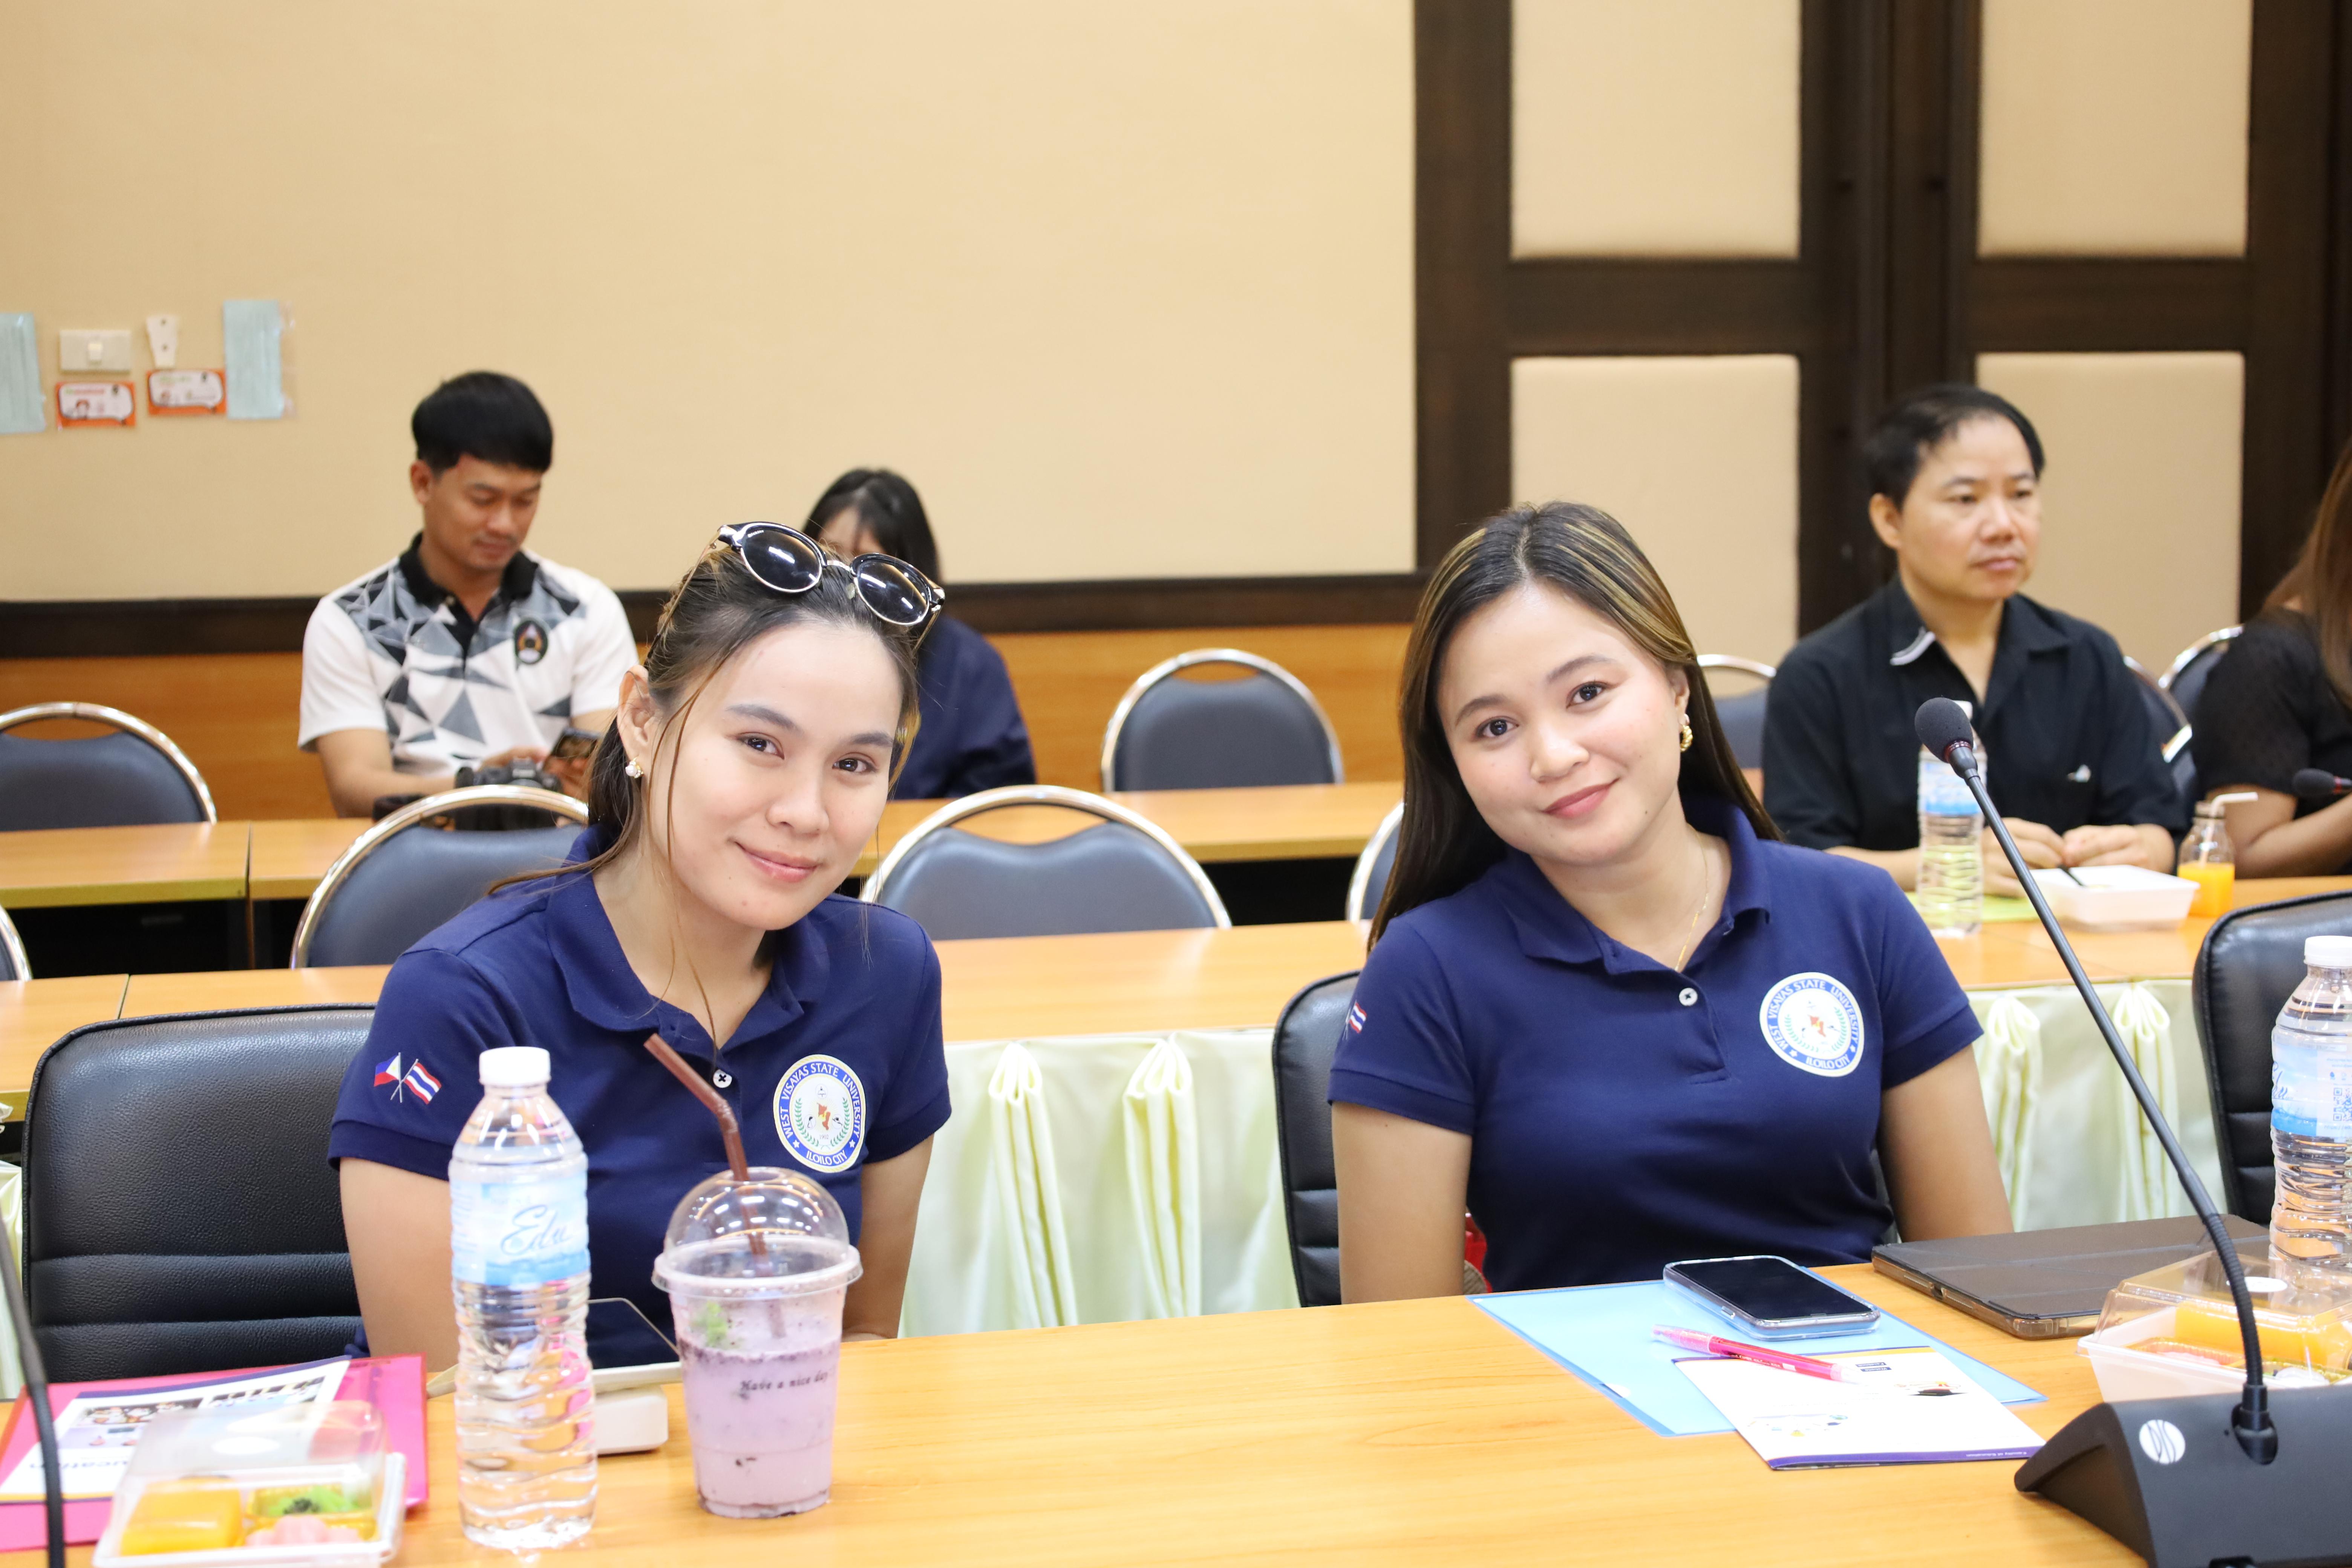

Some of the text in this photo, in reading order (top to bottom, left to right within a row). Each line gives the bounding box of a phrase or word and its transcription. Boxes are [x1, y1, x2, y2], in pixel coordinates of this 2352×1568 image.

[1768, 980, 1859, 1050] WEST VISAYAS STATE UNIVERSITY
[1806, 1054, 1850, 1069] ILOILO CITY
[780, 1063, 861, 1138] WEST VISAYAS STATE UNIVERSITY
[806, 1150, 848, 1165] ILOILO CITY
[501, 1205, 571, 1256] Edu
[740, 1380, 772, 1390] Have
[790, 1377, 810, 1387] nice
[814, 1370, 828, 1384] day
